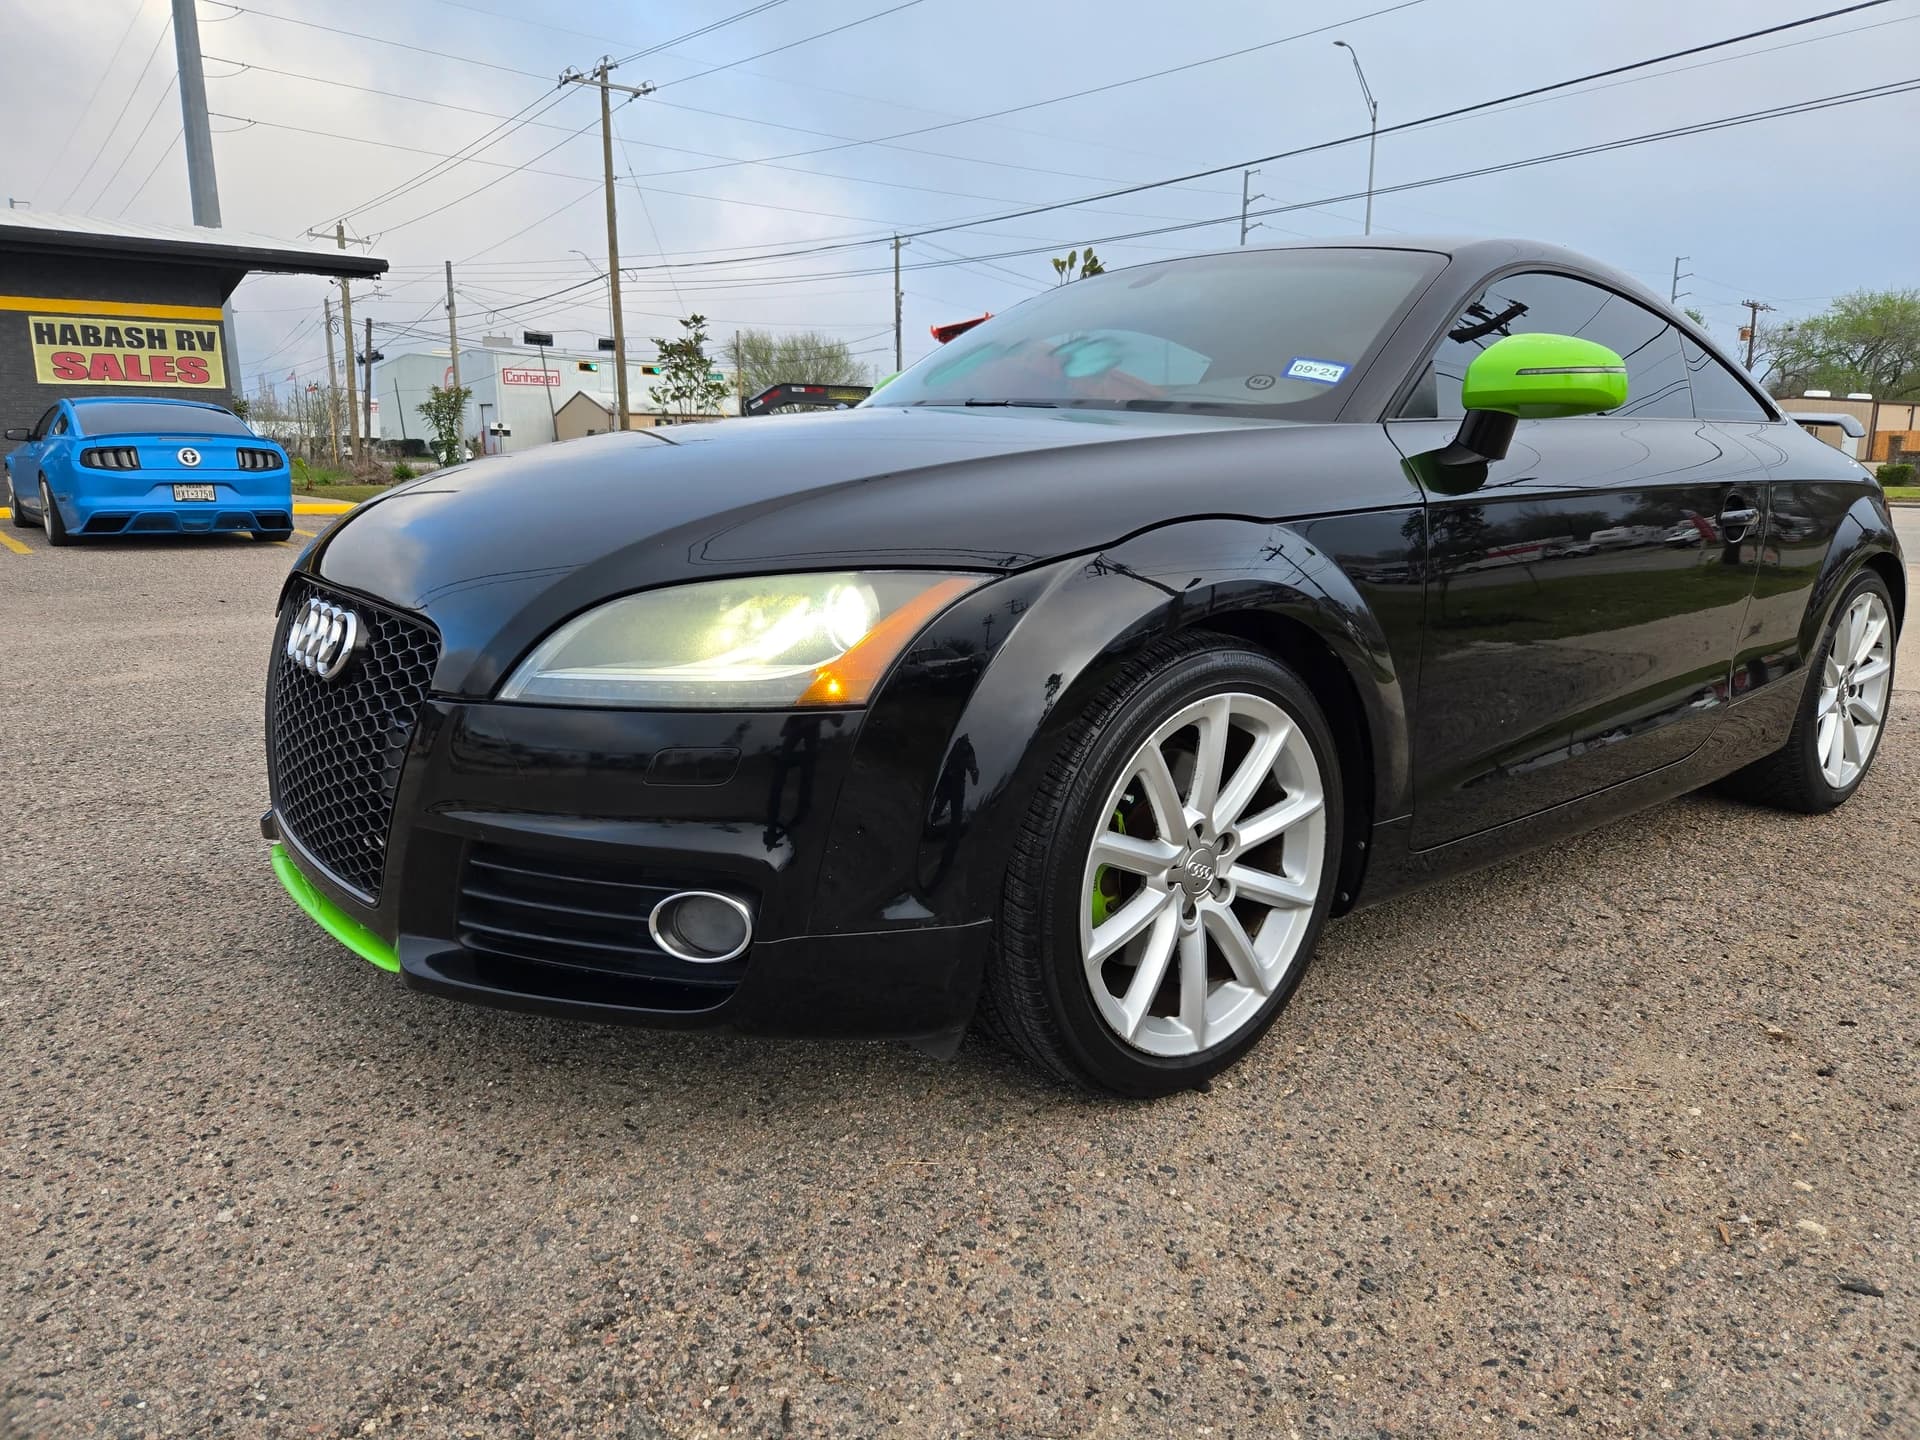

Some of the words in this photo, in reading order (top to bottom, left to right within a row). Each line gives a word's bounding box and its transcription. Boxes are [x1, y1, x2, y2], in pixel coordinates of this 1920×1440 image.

[34, 322, 168, 350] HABASH
[175, 329, 216, 352] RV
[51, 351, 210, 384] SALES
[505, 371, 558, 384] Conhagen
